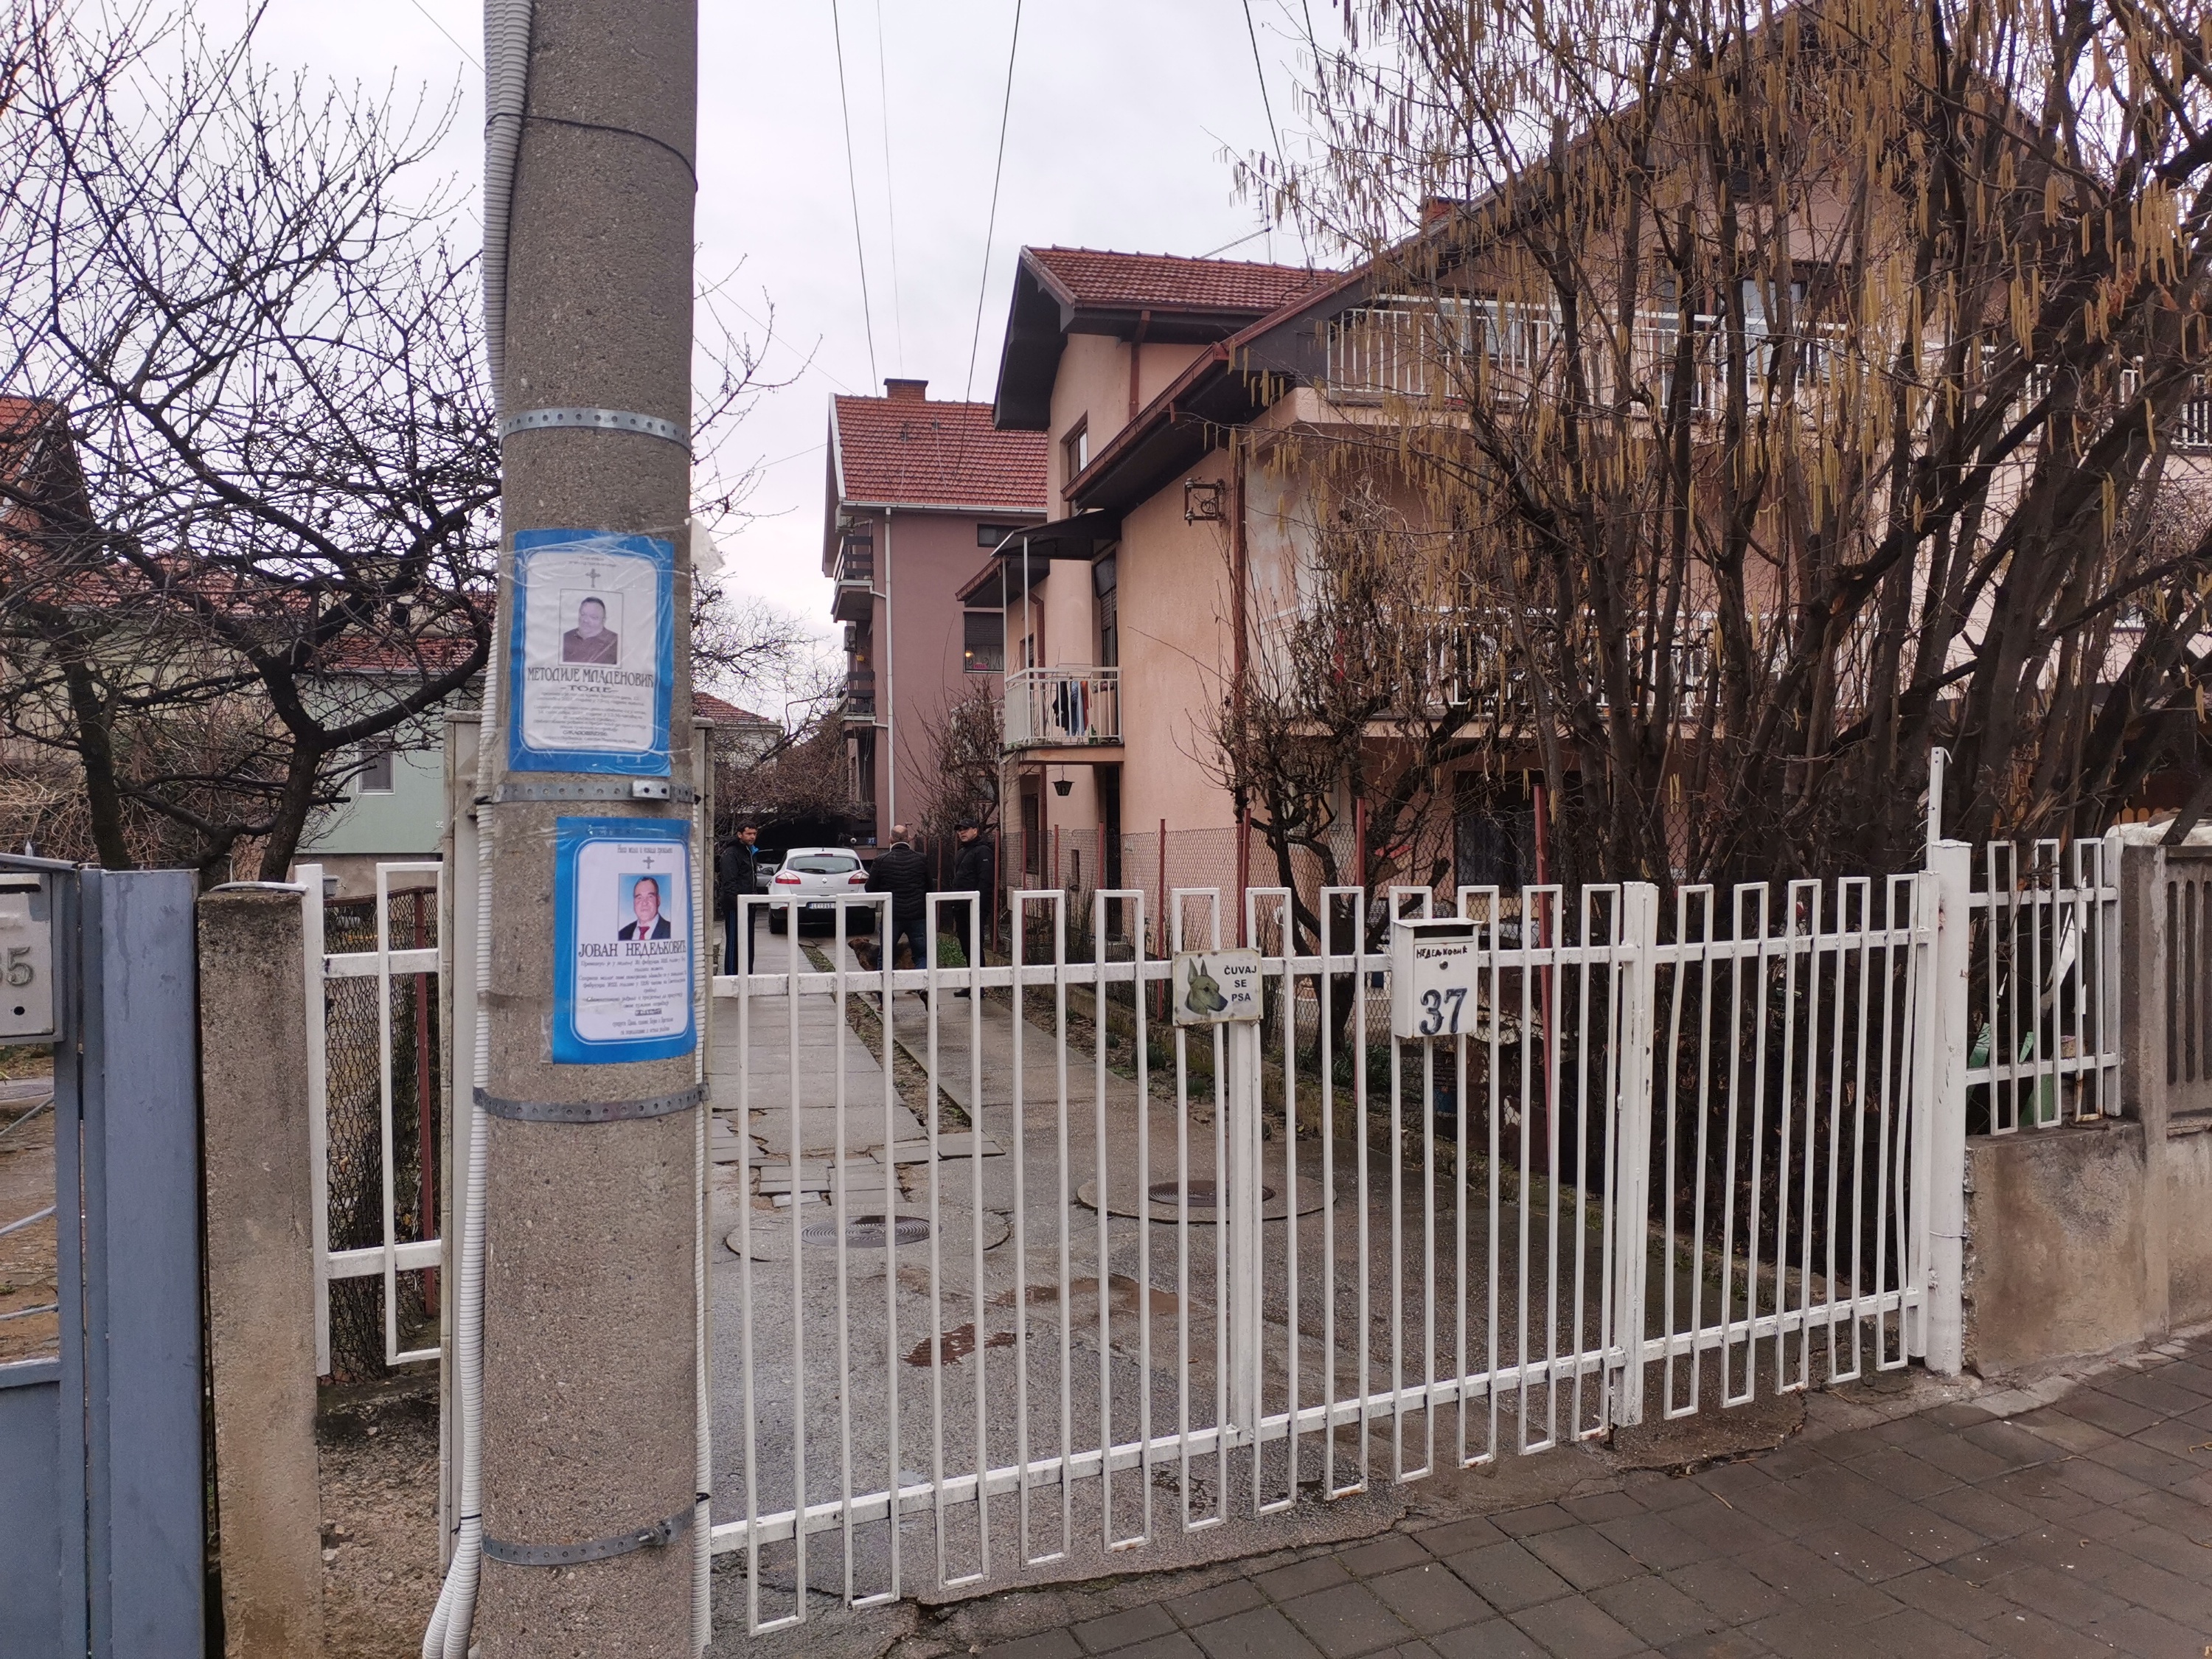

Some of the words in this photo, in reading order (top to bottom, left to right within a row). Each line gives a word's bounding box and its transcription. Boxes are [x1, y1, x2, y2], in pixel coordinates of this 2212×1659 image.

[527, 667, 580, 683] МЕТОДИЈЕ
[582, 668, 654, 688] МЛАДЕНОВИЋ
[578, 943, 618, 957] ЈОВАН
[626, 940, 686, 960] НЕДЕЉКОВИЋ
[0, 946, 34, 986] 5
[1224, 964, 1257, 975] ČUVAJ
[1234, 979, 1248, 988] SE
[1231, 992, 1251, 1002] PSA
[1418, 987, 1468, 1035] 37
